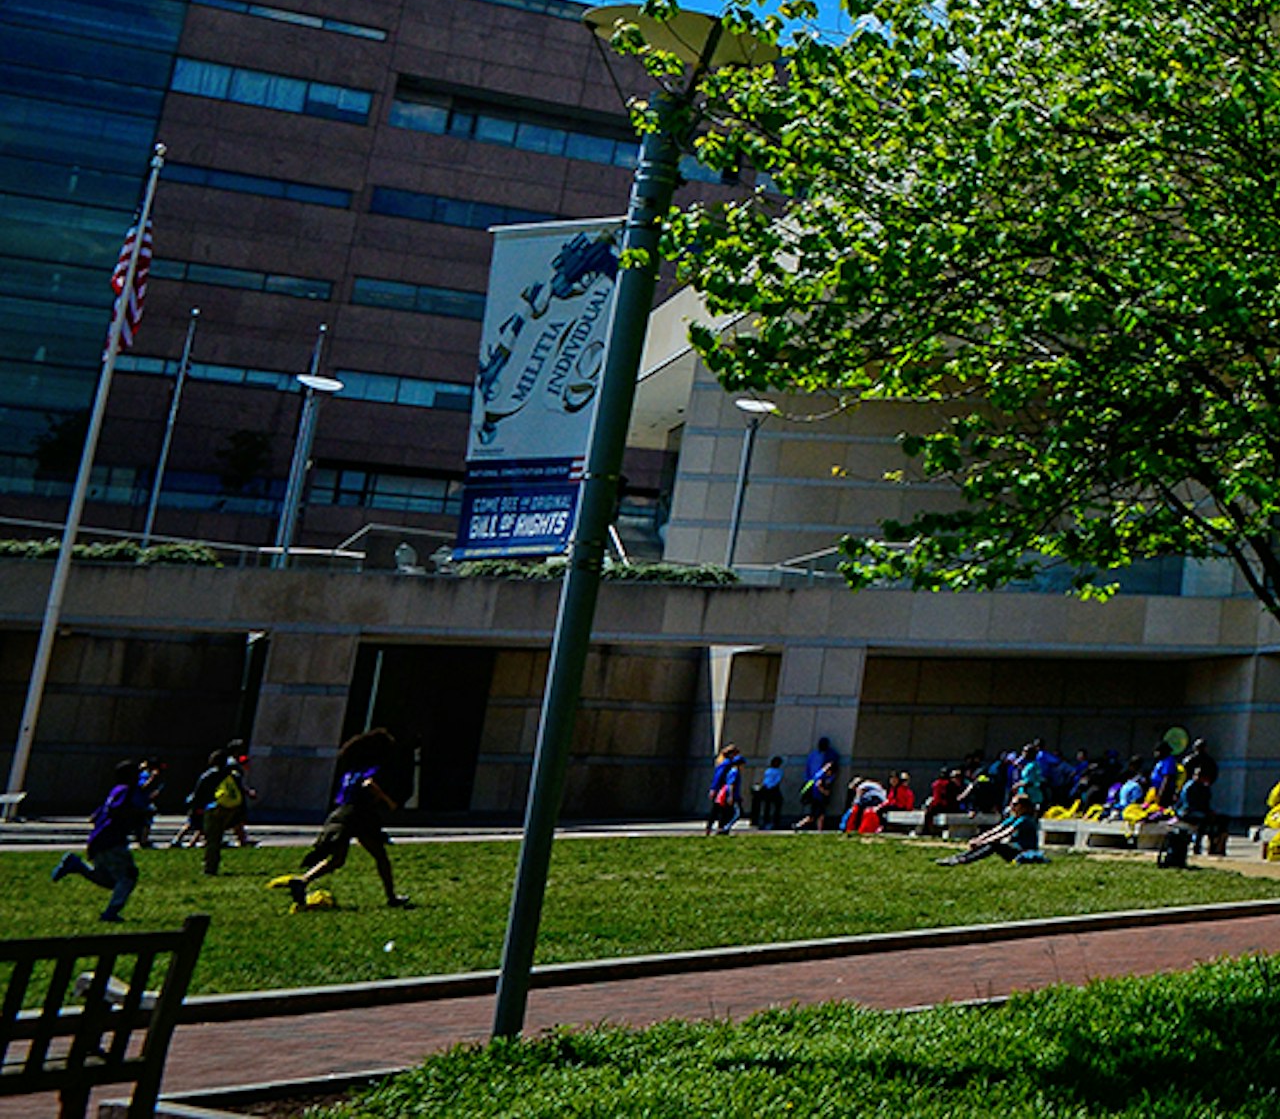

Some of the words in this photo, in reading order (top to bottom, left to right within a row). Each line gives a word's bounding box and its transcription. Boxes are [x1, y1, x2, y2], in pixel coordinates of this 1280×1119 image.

[511, 320, 567, 403] MILITIA
[547, 286, 612, 396] INDIVIDUAL
[469, 514, 499, 540] BILL
[499, 512, 517, 537] OF
[513, 510, 570, 538] RIGHTS
[530, 494, 573, 511] ORIGINAL
